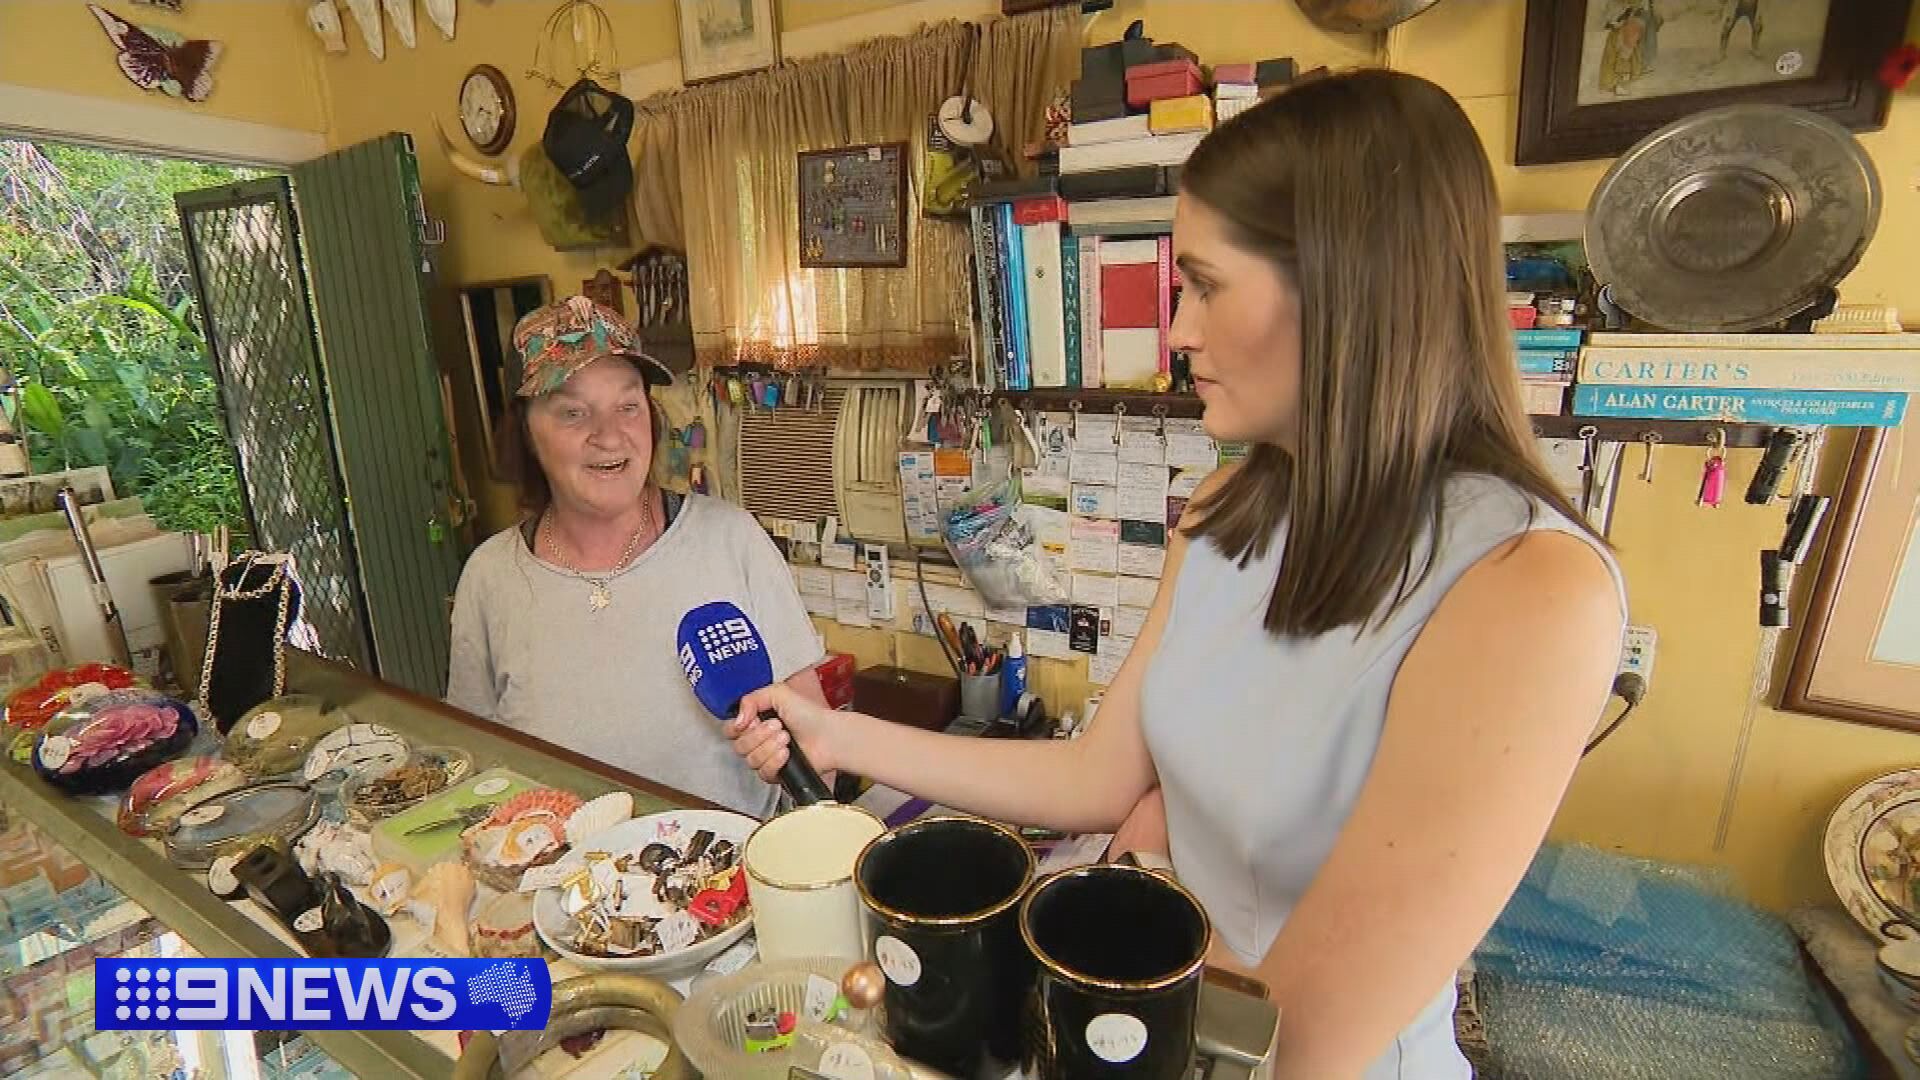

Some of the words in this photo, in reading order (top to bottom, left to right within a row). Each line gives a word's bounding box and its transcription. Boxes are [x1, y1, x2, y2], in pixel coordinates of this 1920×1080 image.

[1594, 360, 1750, 380] CARTER'S
[1605, 391, 1656, 408] ALAN
[1663, 395, 1745, 413] CARTER
[707, 637, 759, 664] NEWS
